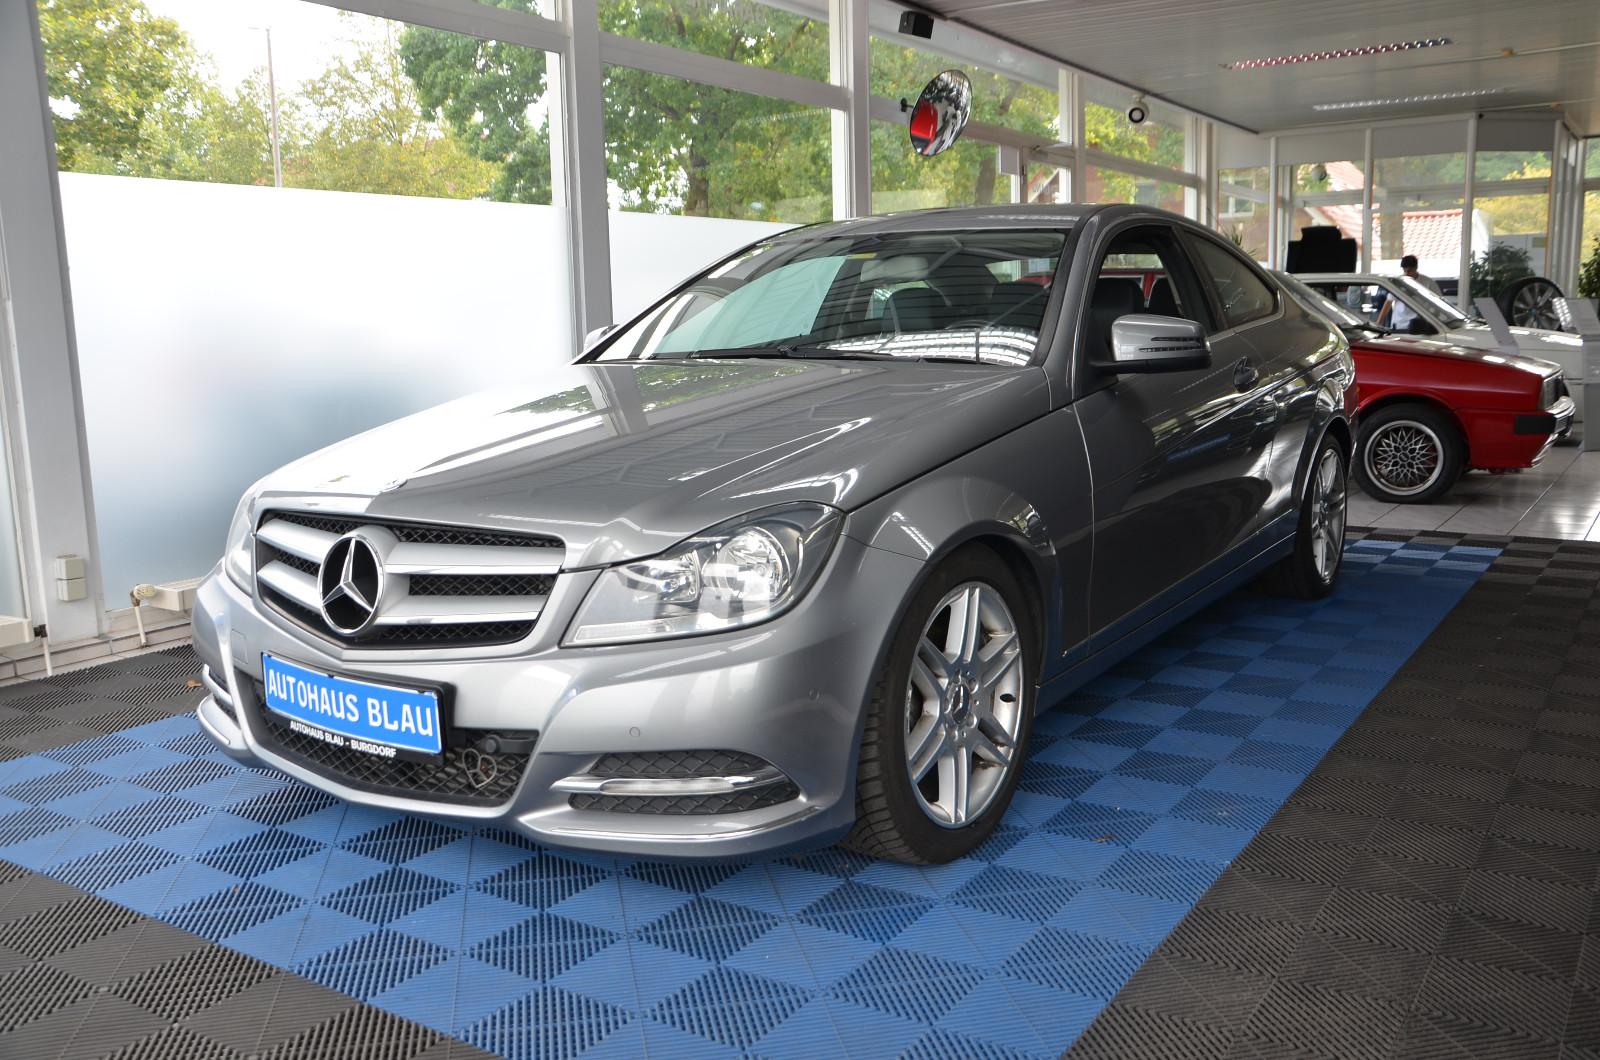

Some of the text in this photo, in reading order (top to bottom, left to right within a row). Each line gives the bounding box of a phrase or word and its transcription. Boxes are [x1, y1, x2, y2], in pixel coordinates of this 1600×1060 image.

[269, 669, 433, 737] AUTOHAUS BLAU
[290, 720, 324, 740] AUTOHAUS
[325, 734, 344, 746] BLAU
[351, 740, 396, 758] BURGDORF
